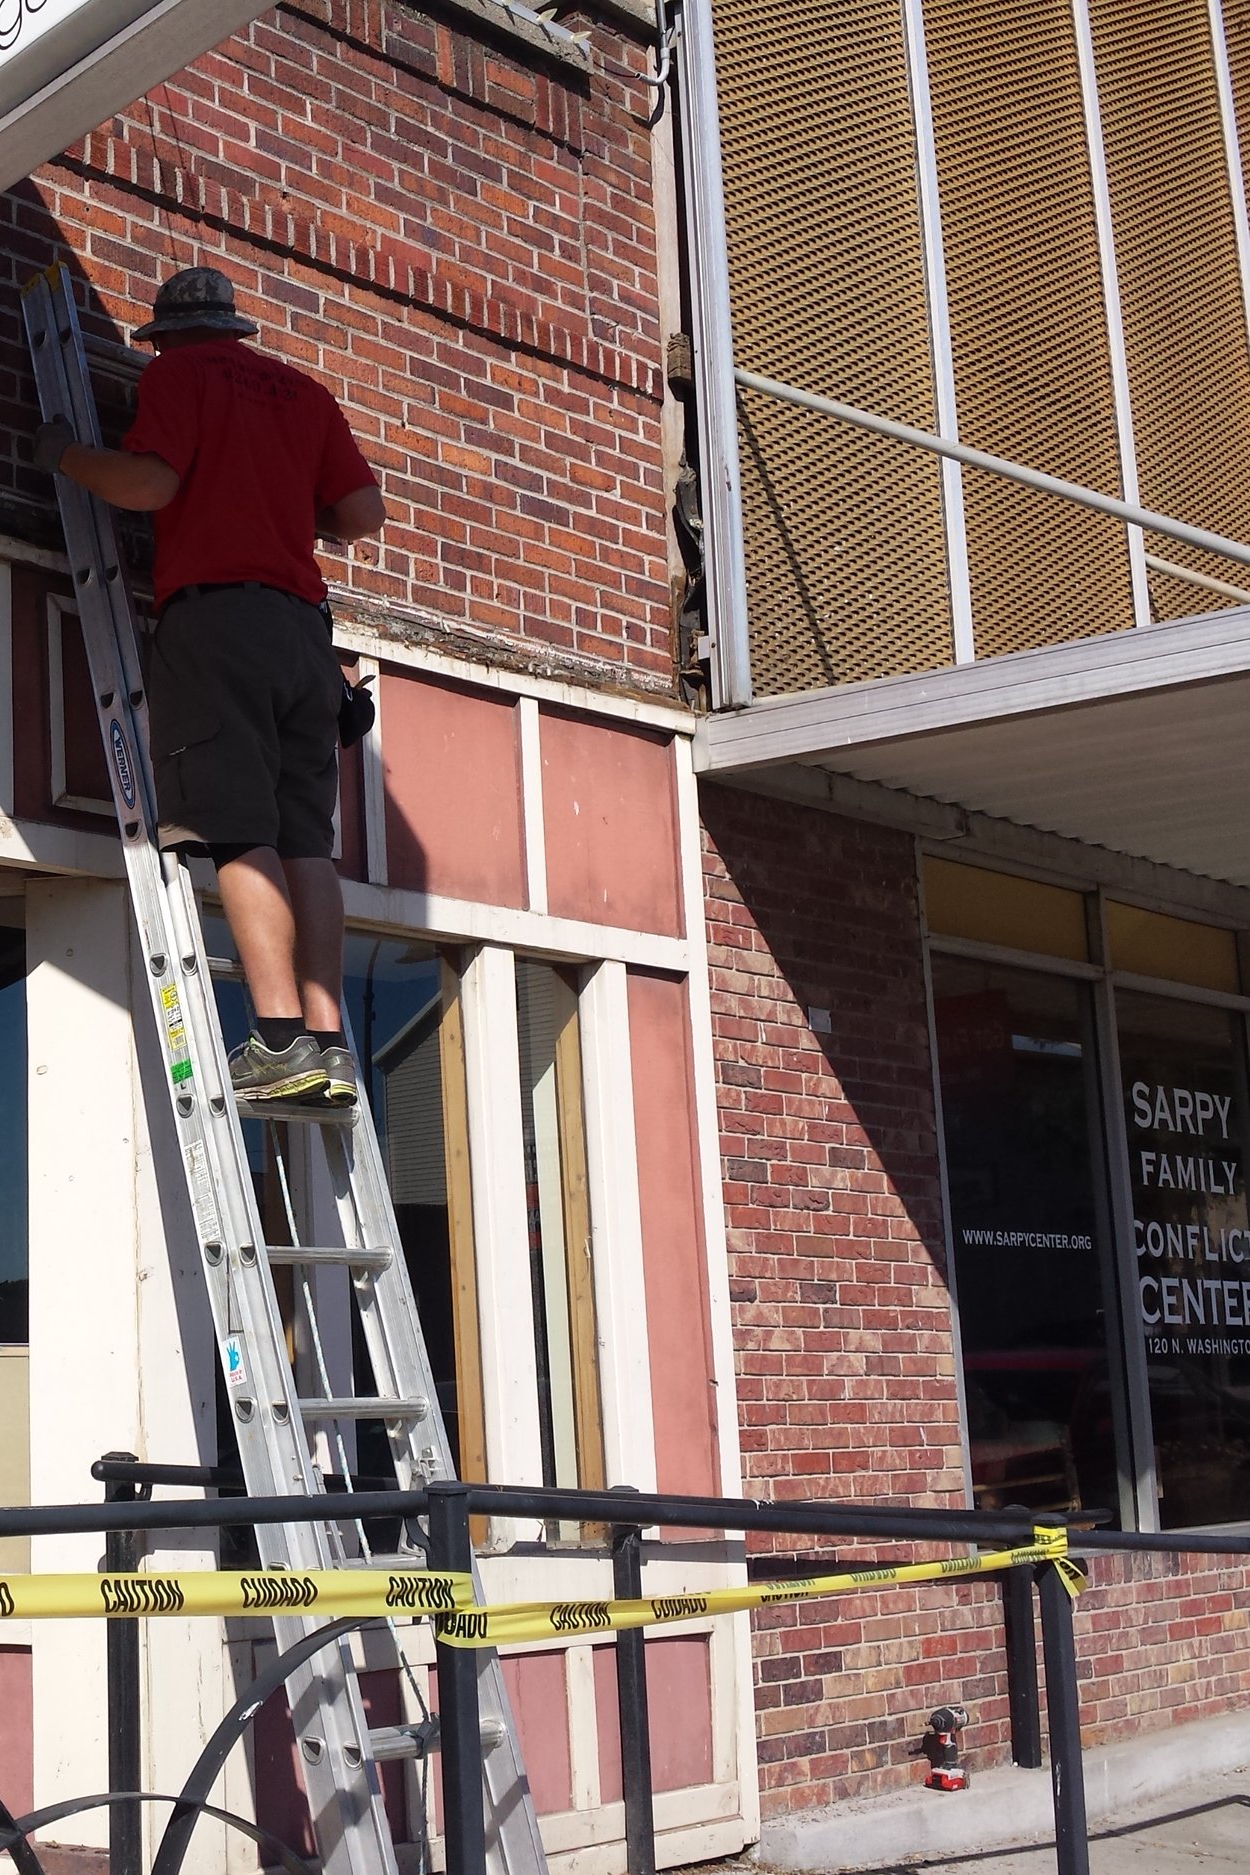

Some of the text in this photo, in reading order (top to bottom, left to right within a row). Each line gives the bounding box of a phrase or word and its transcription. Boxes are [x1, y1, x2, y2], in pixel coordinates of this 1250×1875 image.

[115, 736, 132, 791] WERNER
[1132, 1081, 1231, 1139] SARPY
[1140, 1151, 1237, 1195] FAMILY
[962, 1229, 1092, 1250] WWW.SARPYCENTER.ORG
[1149, 1338, 1168, 1354] 120
[1171, 1338, 1184, 1354] N.
[100, 1579, 185, 1612] CAUTION
[240, 1577, 318, 1609] CUIDADO
[386, 1576, 455, 1609] CAUTION
[550, 1602, 612, 1631] CAUTION
[651, 1598, 708, 1620] CUIDADO
